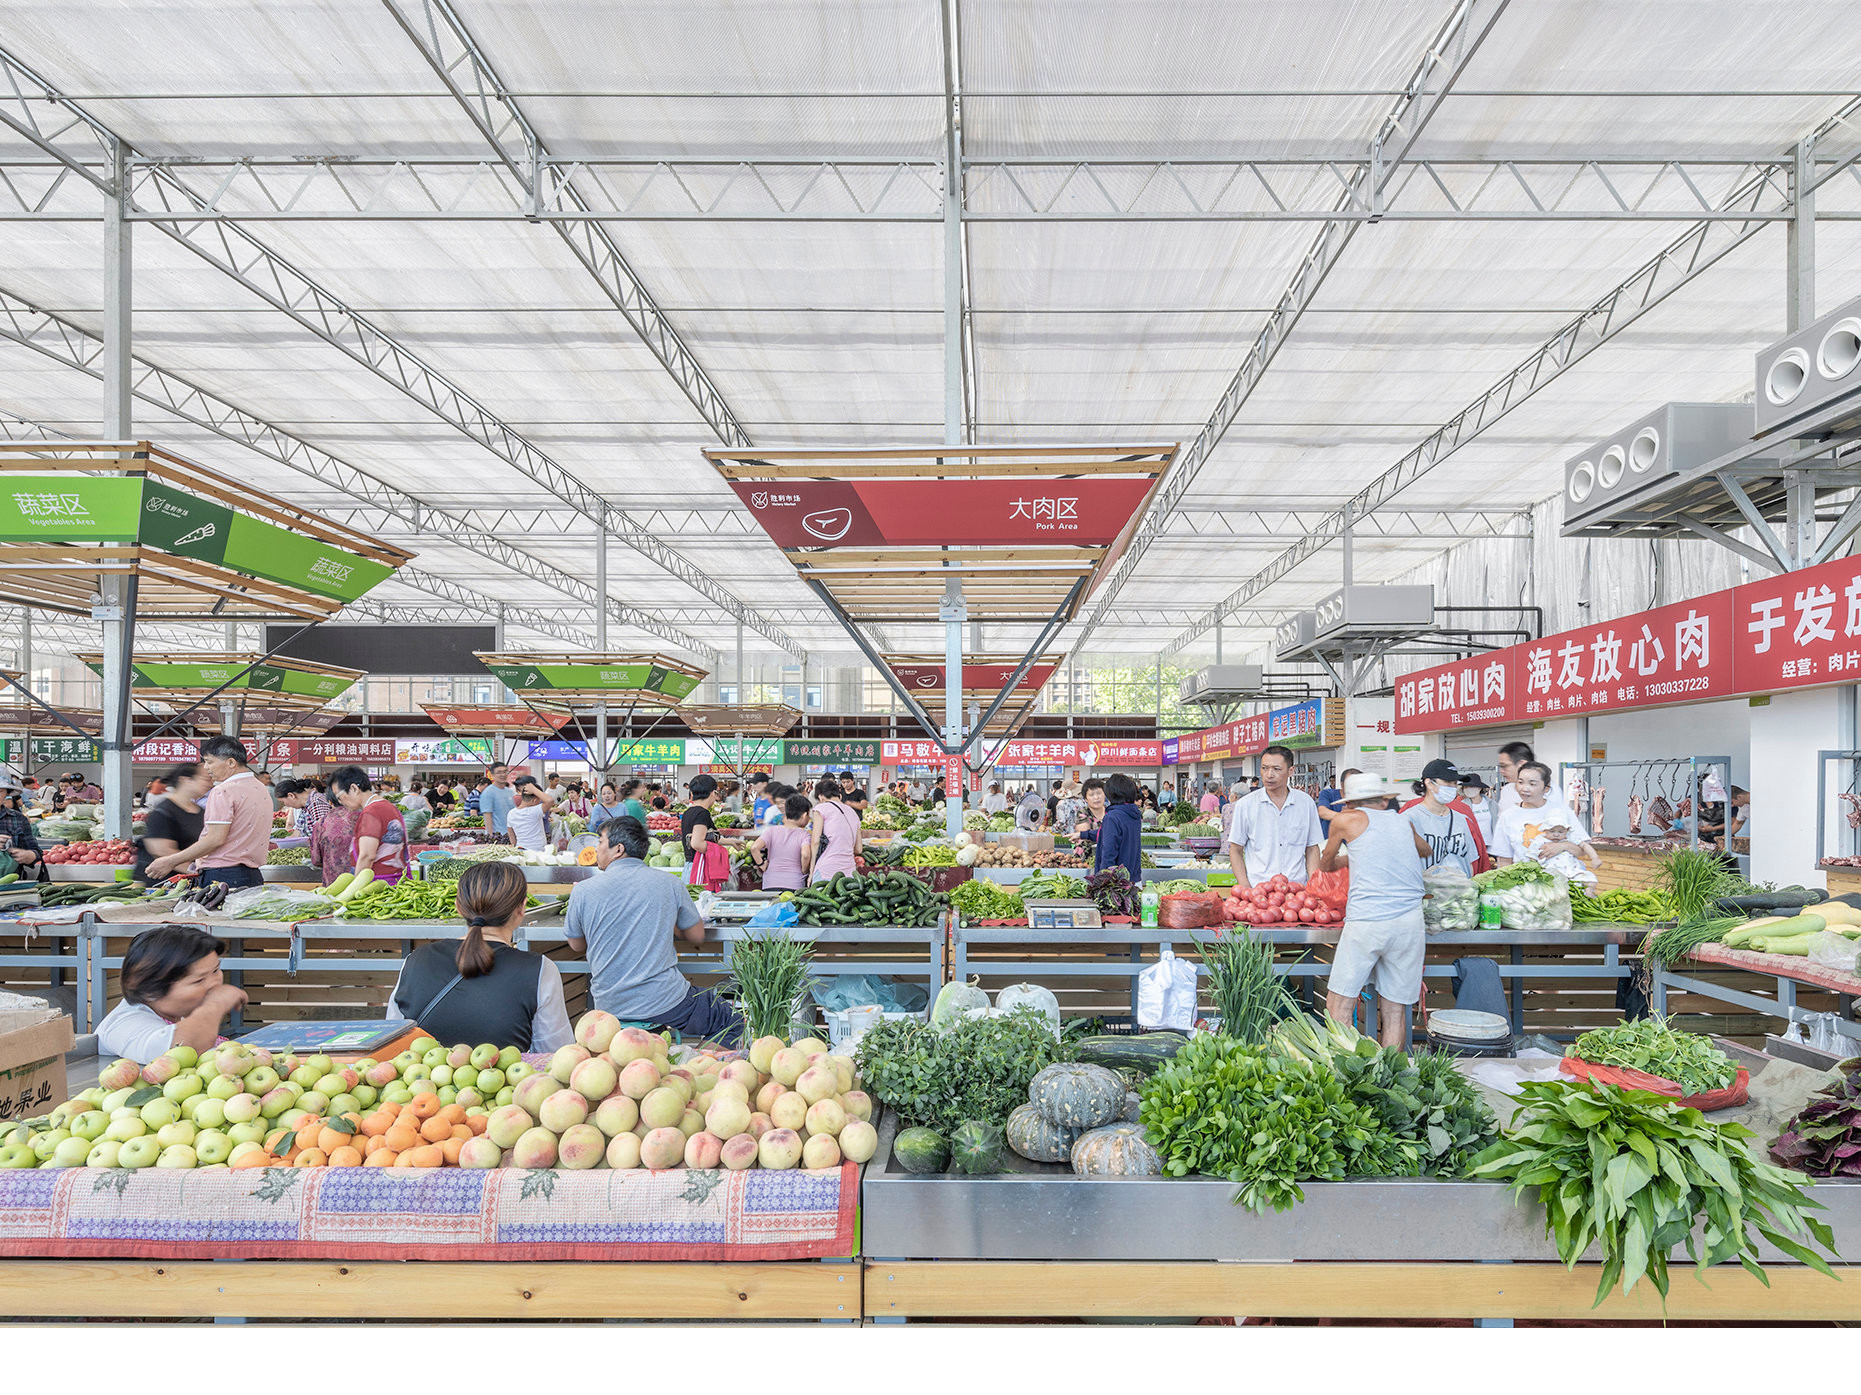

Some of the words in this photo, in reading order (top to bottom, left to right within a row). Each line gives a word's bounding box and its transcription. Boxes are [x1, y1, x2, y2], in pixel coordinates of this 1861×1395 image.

[12, 493, 90, 515] 蔬菜区
[1009, 497, 1078, 520] 大肉区
[28, 518, 75, 526] Vegetables
[310, 557, 354, 582] 蔬菜区
[1525, 610, 1710, 696] 海友放心肉
[1400, 661, 1505, 718] 胡家放心肉
[1233, 720, 1265, 745] 胖子土猪肉
[303, 743, 391, 755] 一分利粮油调料店
[621, 744, 680, 757] 马家牛羊肉
[1008, 744, 1075, 757] 张家牛羊肉
[1100, 747, 1157, 757] 四川鲜面条店
